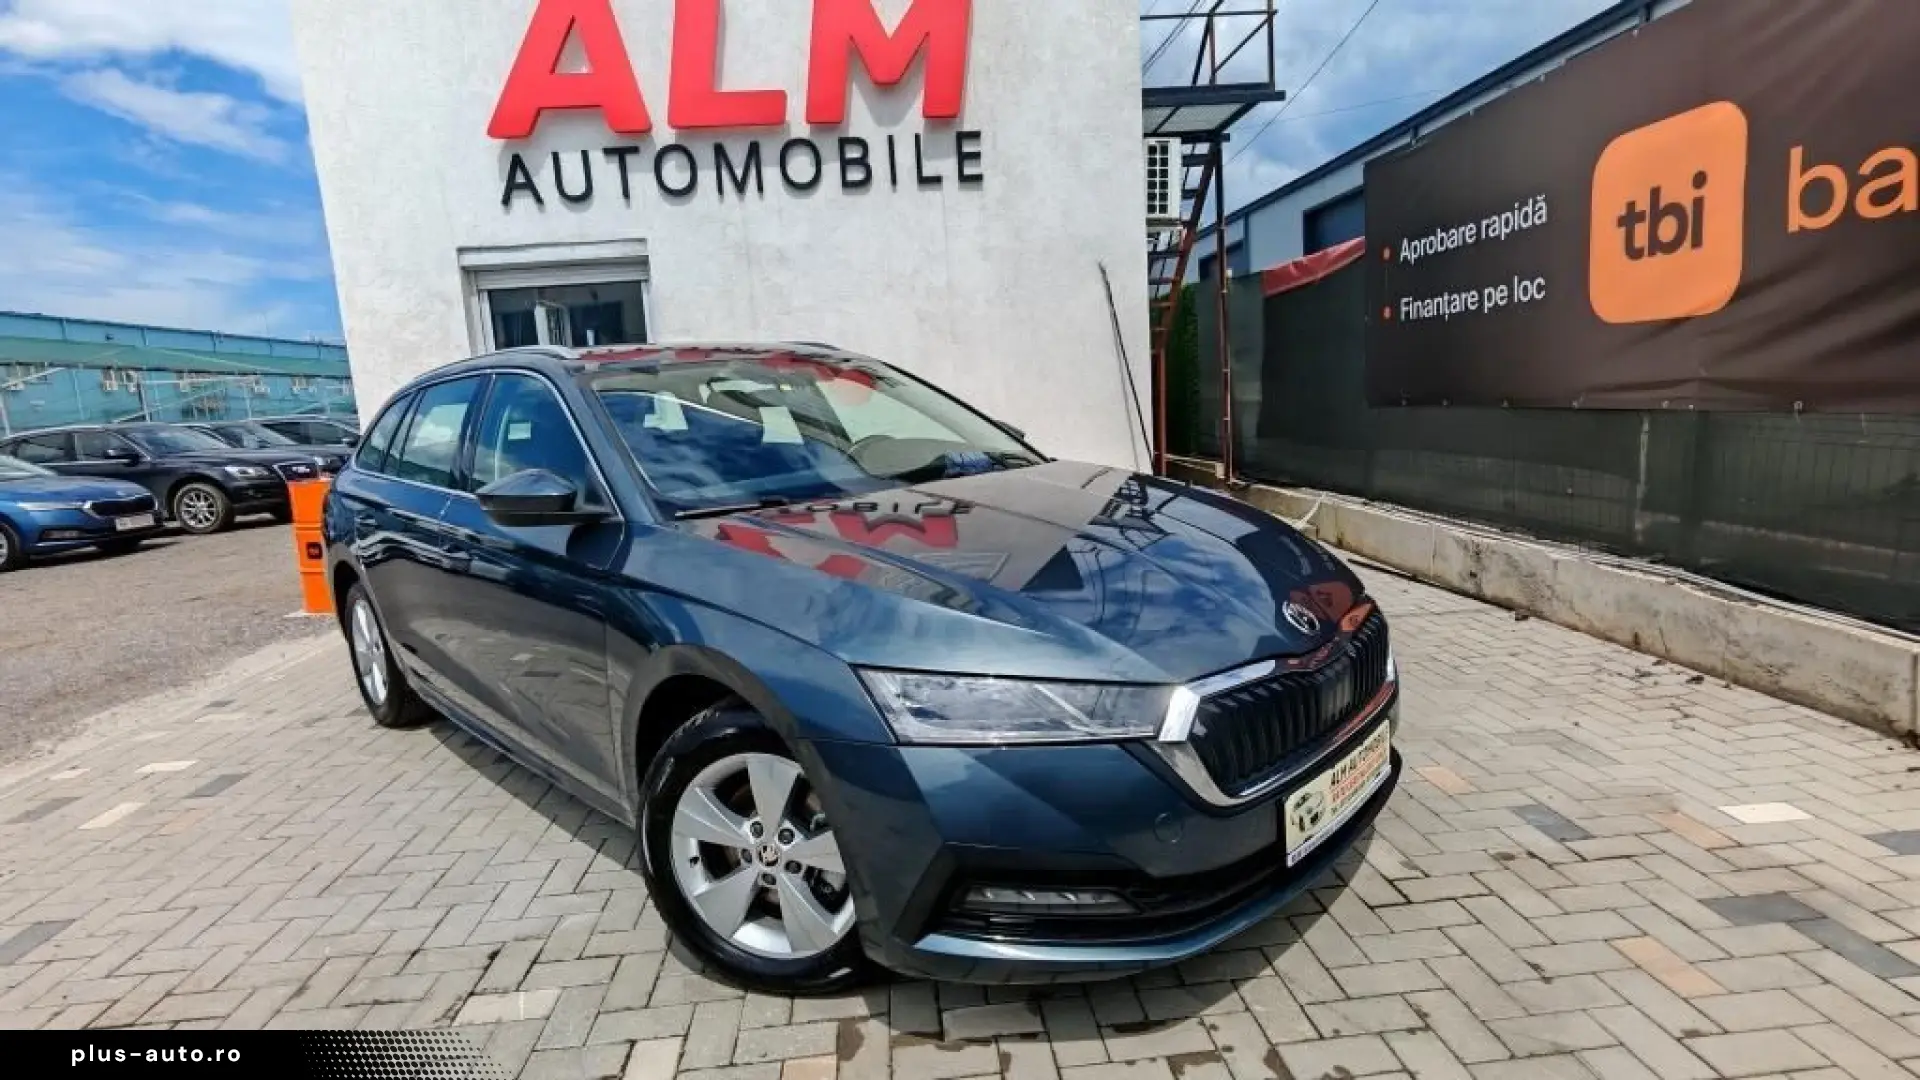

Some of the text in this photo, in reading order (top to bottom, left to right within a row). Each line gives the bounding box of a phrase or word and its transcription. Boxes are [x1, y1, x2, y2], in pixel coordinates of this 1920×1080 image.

[487, 0, 973, 139] ALM
[501, 130, 985, 207] AUTOMOBILE
[1616, 145, 1918, 261] tbi ba
[1400, 194, 1548, 266] Aprobare rapidă
[1400, 275, 1546, 322] Finanțare pe loc
